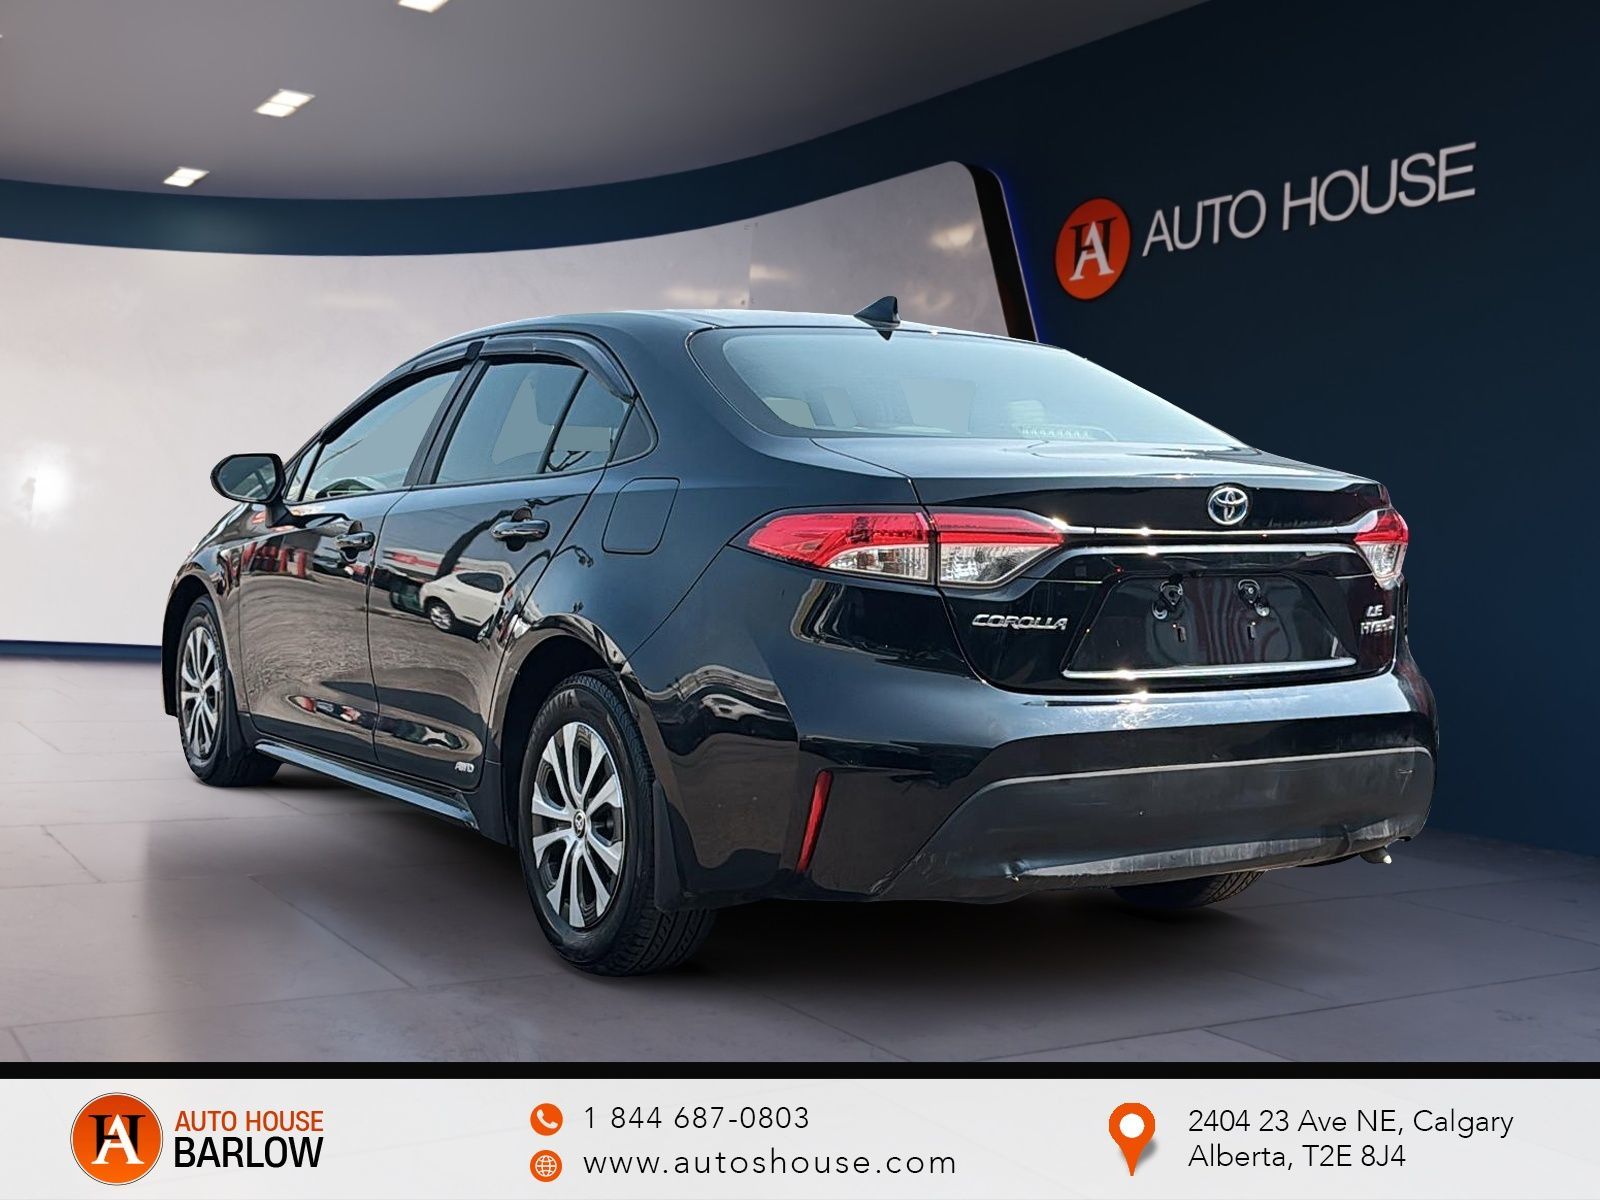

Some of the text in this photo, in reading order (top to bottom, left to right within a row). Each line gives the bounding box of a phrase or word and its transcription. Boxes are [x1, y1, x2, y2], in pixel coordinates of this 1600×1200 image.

[1141, 141, 1477, 257] AUTO HOUSE
[1366, 604, 1384, 617] LE
[971, 613, 1069, 631] COROLLA
